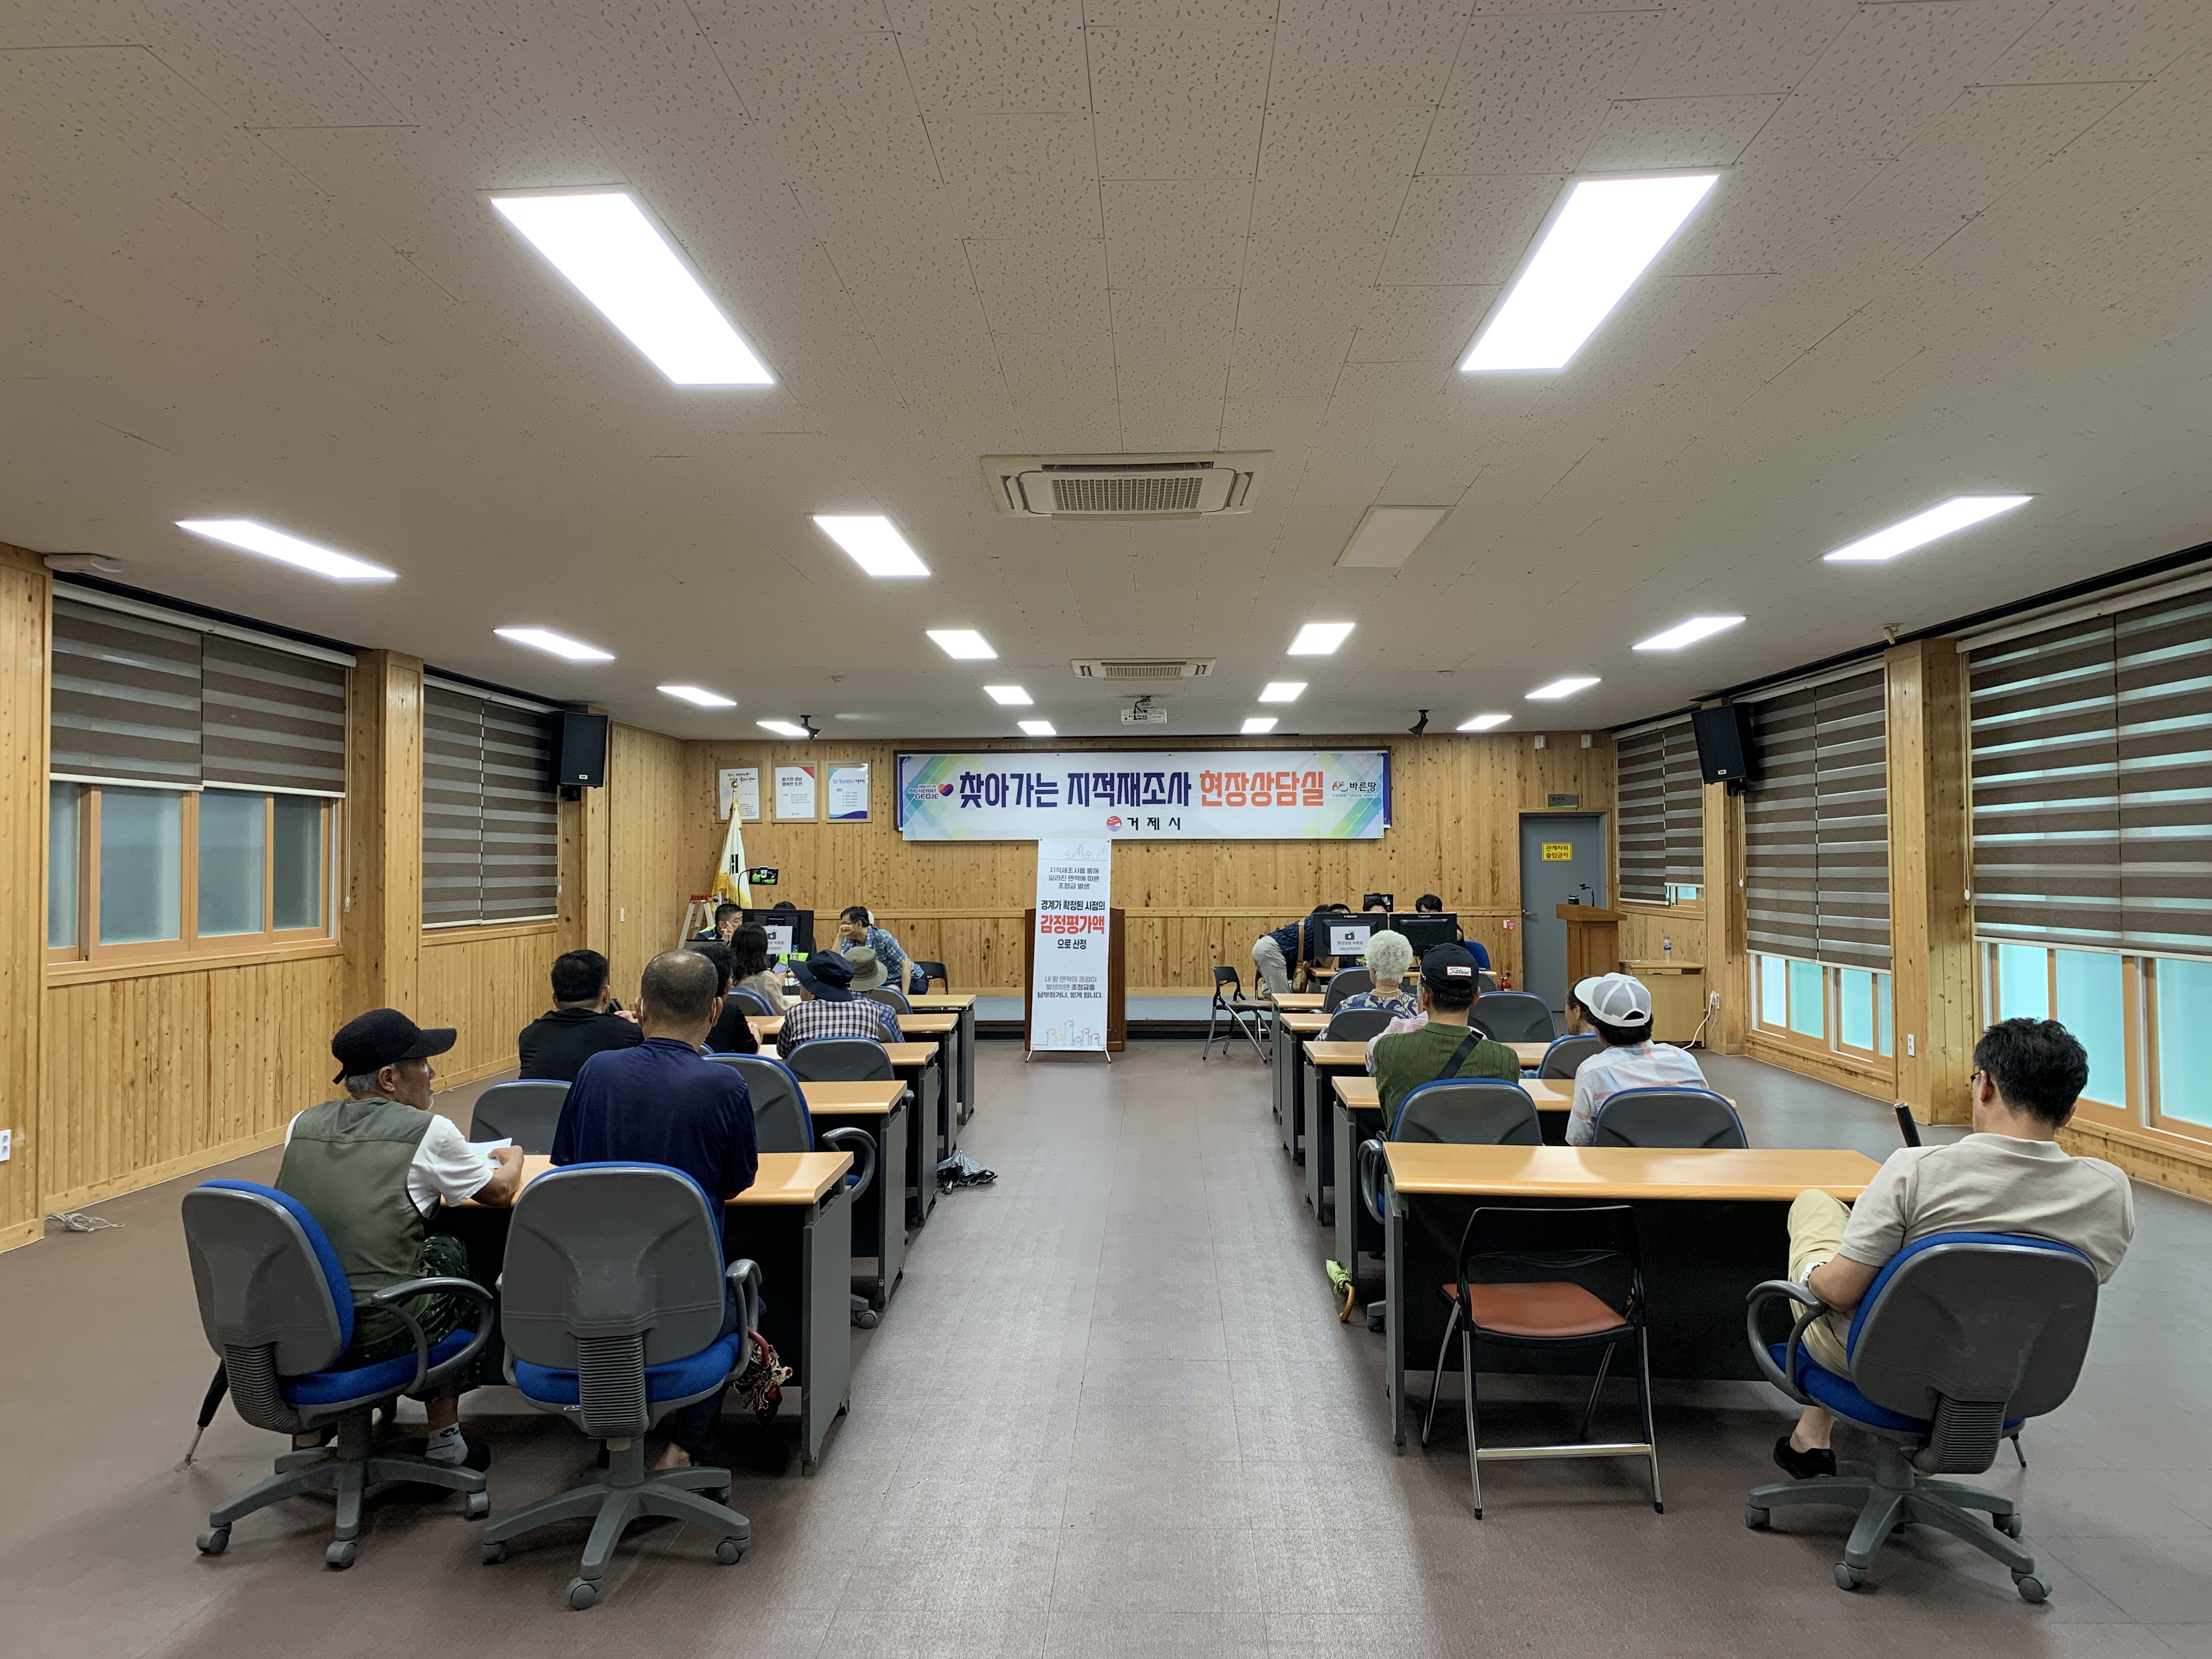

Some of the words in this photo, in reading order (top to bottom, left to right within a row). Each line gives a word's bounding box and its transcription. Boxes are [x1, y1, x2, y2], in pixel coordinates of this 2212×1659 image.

[960, 771, 1058, 808] 찾아가는
[1068, 772, 1192, 807] 지적재조사
[1199, 770, 1324, 807] 현장상담실
[1350, 782, 1376, 792] 바른땅
[1041, 900, 1062, 910] 경계가
[1063, 900, 1084, 911] 확정된
[1085, 901, 1105, 911] 시점의
[1040, 915, 1105, 934] 감정평가액
[1057, 939, 1071, 949] 으로
[1073, 939, 1087, 950] 산정
